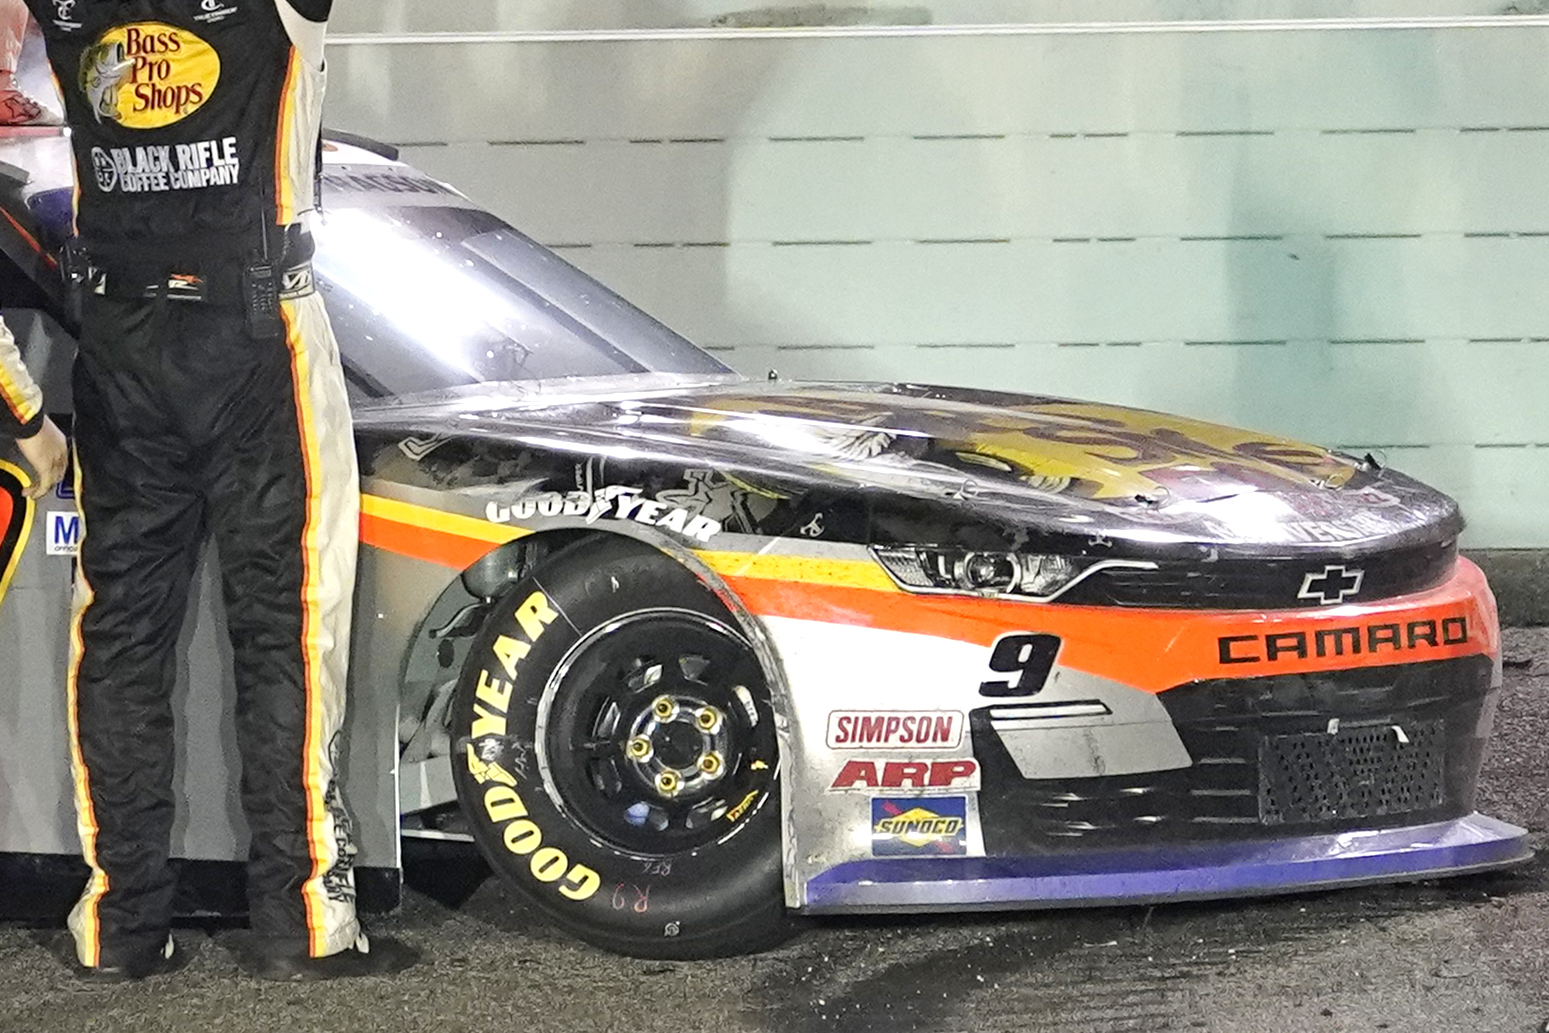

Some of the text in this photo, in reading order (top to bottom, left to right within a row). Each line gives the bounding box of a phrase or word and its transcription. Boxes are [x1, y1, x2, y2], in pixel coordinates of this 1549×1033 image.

[126, 28, 181, 57] Bass
[131, 56, 171, 83] Pro
[132, 82, 204, 116] Shops
[110, 137, 239, 174] BLACK RIFLE
[120, 164, 240, 193] COFFEE COMPANY
[485, 486, 722, 543] GOODYEAR
[1217, 616, 1469, 664] CAMARO
[978, 634, 1063, 698] 9
[467, 590, 601, 901] GOODYEAR
[834, 716, 953, 745] SIMPSON
[831, 759, 977, 788] ARP
[877, 818, 960, 835] SUNOCO
